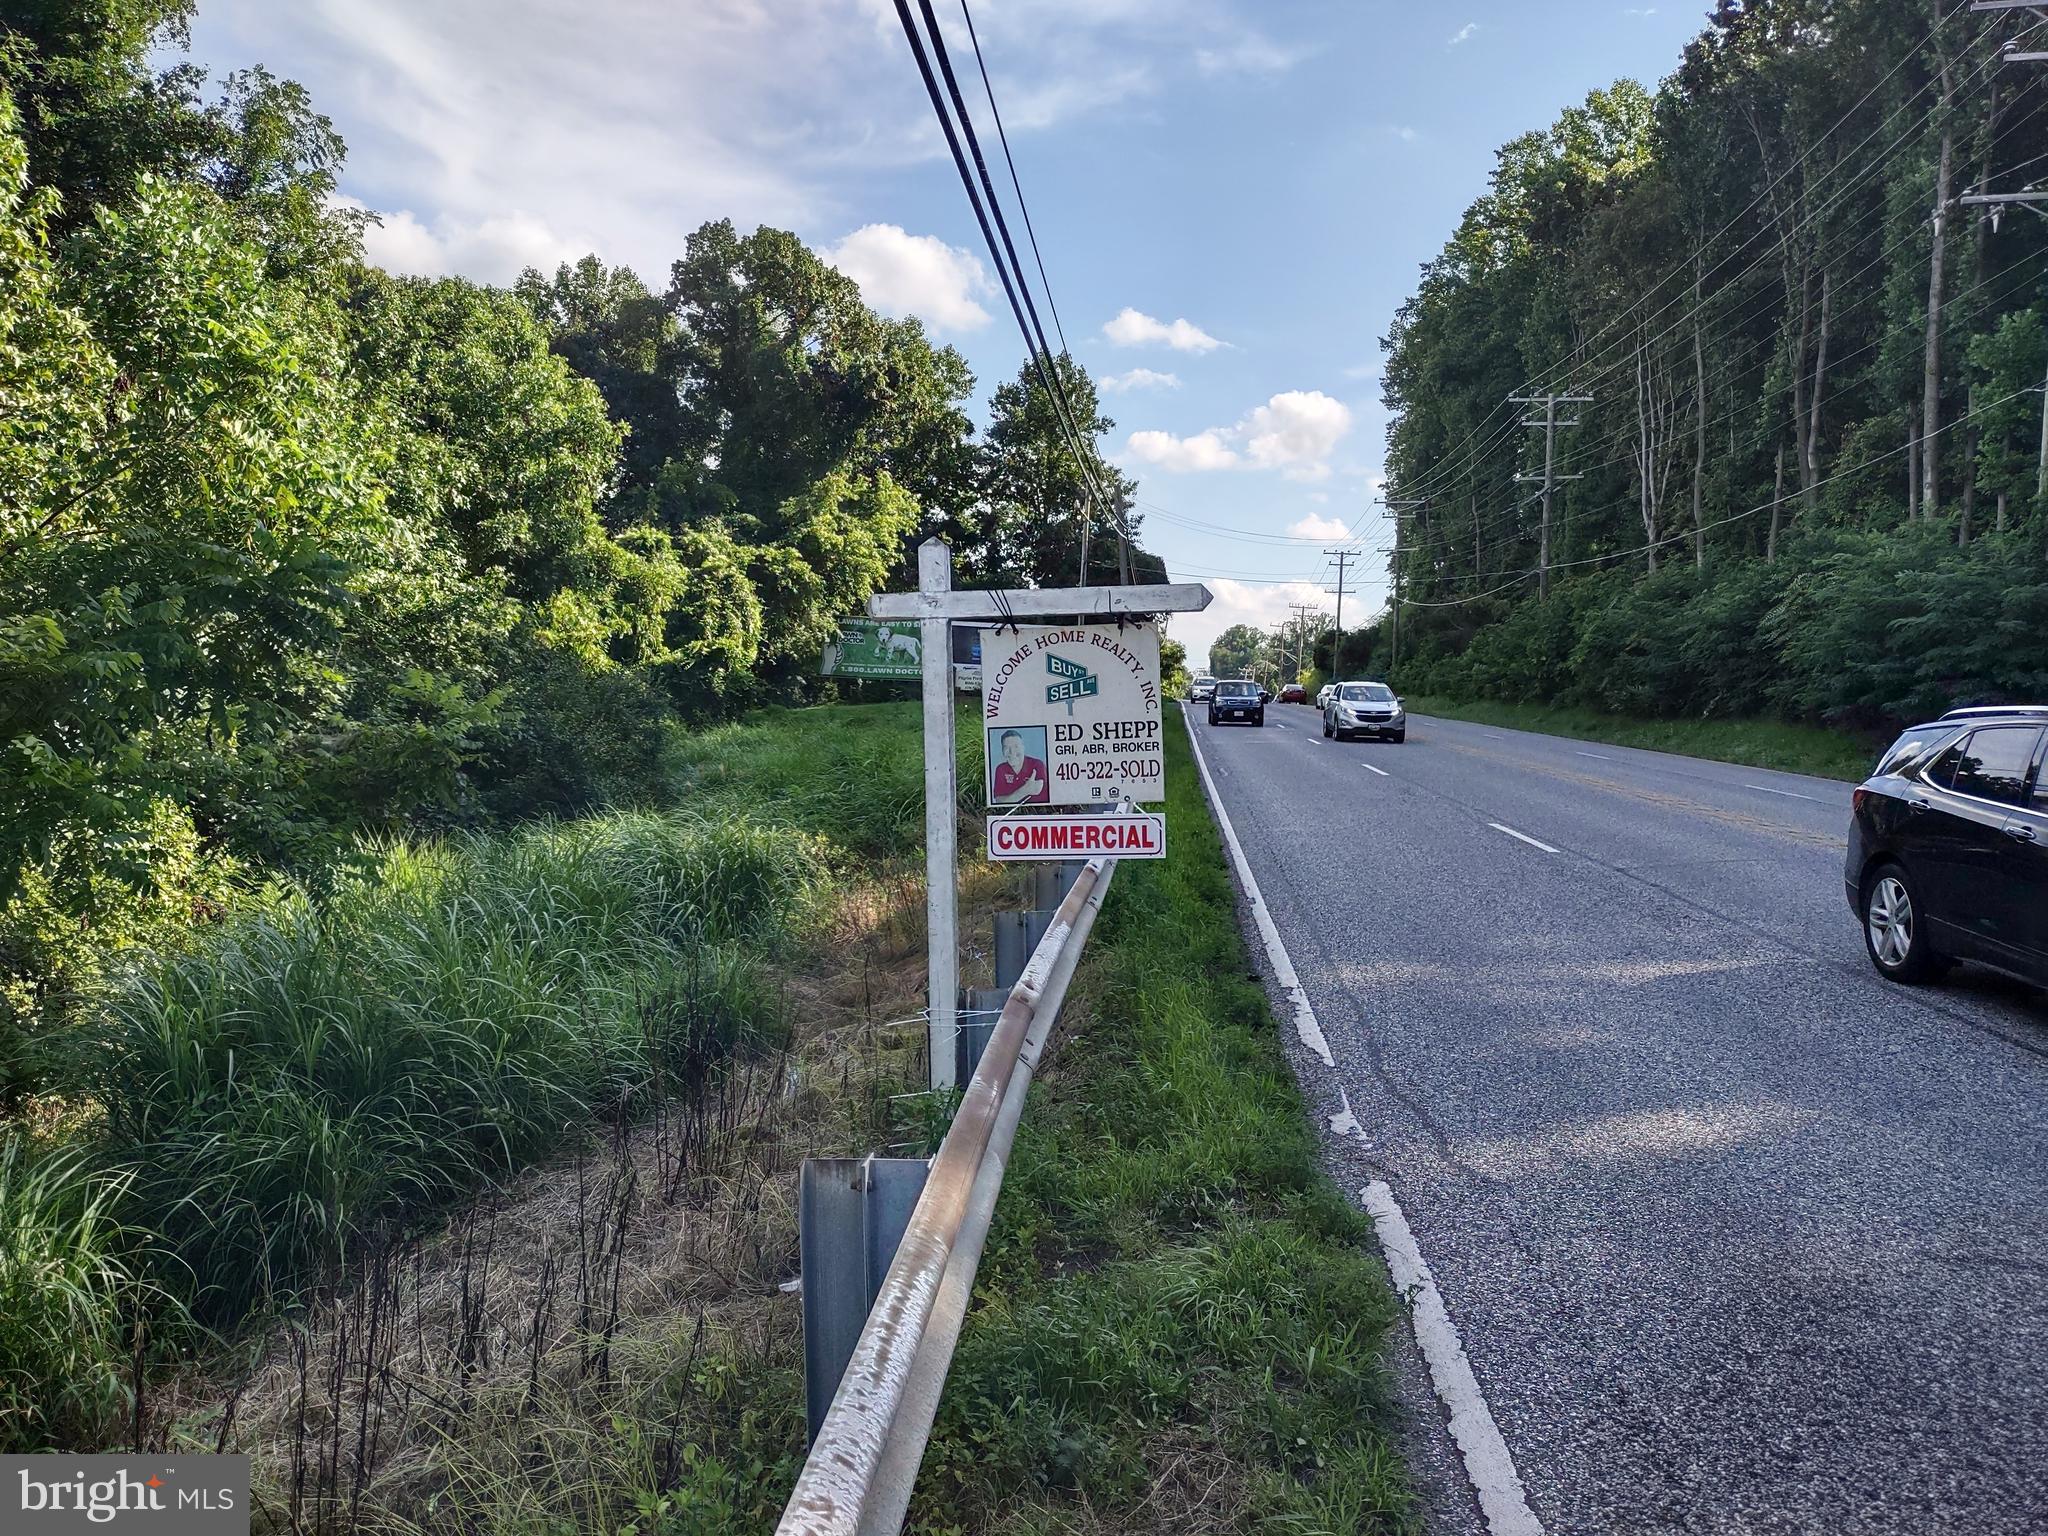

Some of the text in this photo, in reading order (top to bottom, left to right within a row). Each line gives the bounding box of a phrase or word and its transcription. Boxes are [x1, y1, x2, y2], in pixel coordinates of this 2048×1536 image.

[986, 630, 1158, 719] WELCOME HOME REALTY, INC.
[1051, 658, 1078, 677] BUY
[1050, 680, 1091, 700] SELL
[1054, 720, 1158, 742] ED SHEPP
[1055, 742, 1160, 756] GRI, ABR, BROKER
[1056, 760, 1160, 780] 410-322-SOLD
[998, 826, 1154, 850] COMMERCIAL
